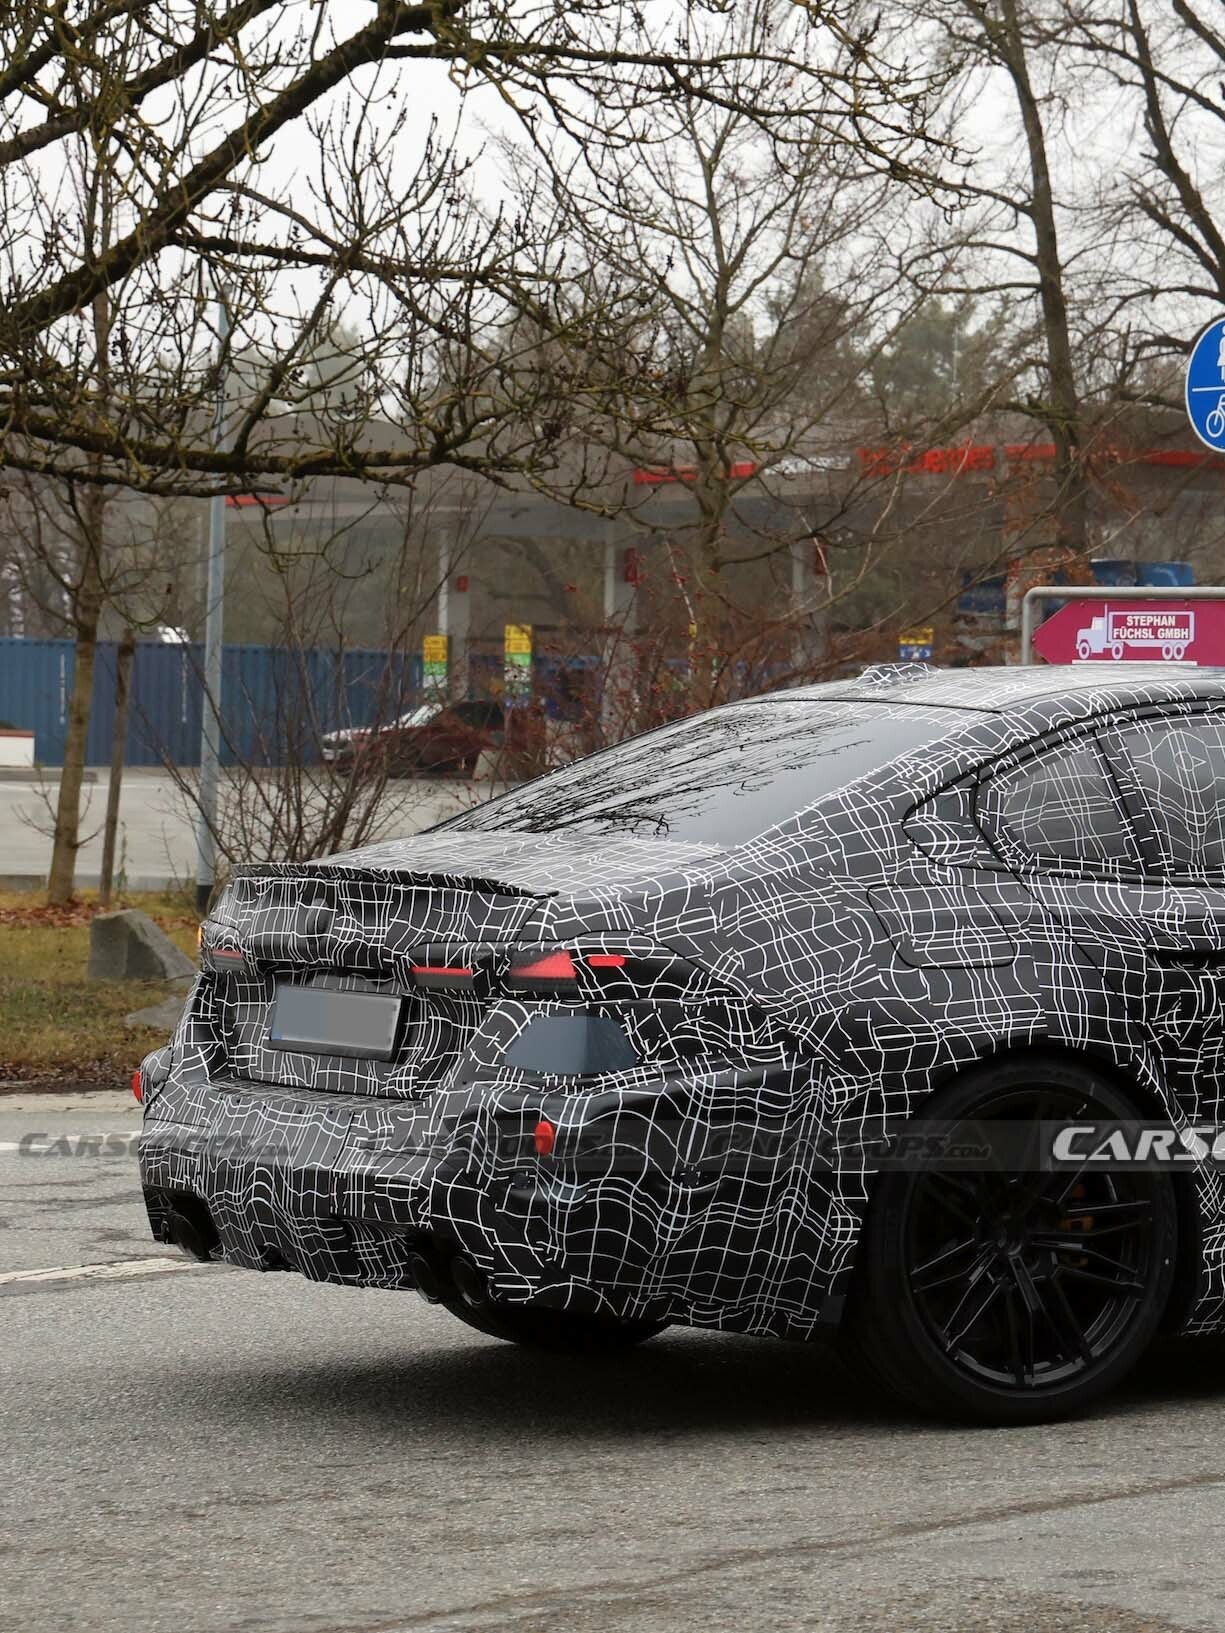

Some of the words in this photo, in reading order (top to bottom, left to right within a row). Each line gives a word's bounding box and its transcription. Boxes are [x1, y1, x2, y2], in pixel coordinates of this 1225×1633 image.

[1126, 616, 1176, 627] STEPHAN
[1113, 626, 1155, 639] FÜCHSL
[1157, 628, 1189, 640] GMBH
